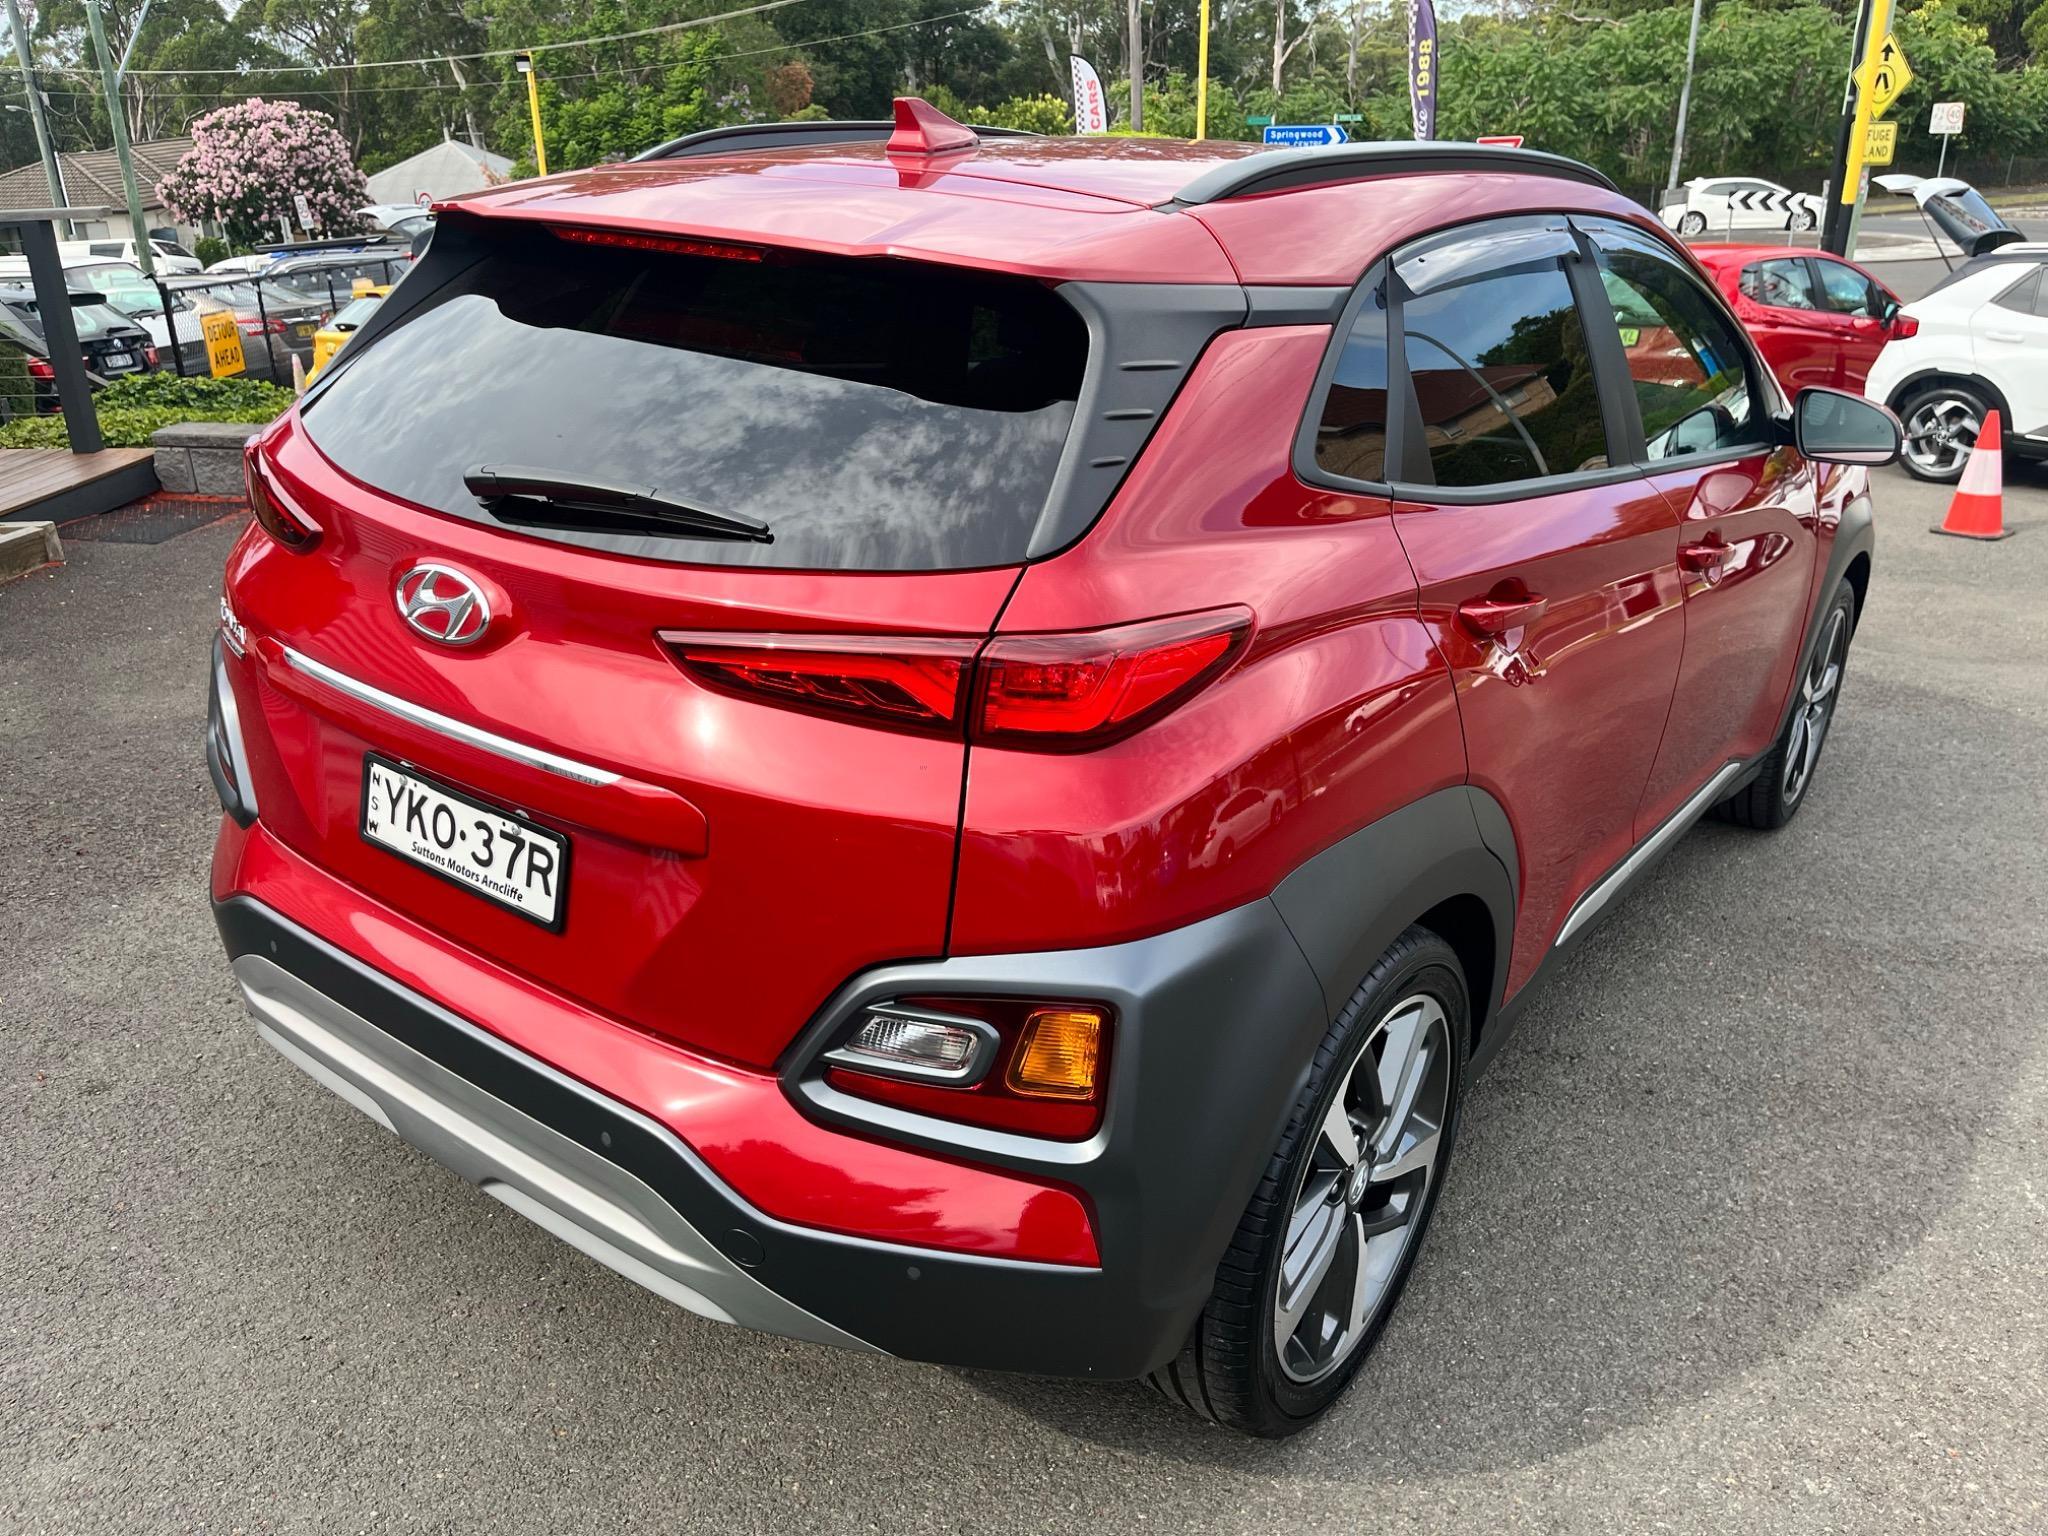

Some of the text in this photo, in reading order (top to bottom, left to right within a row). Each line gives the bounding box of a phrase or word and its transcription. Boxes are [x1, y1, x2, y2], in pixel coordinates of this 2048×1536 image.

[1416, 38, 1433, 102] 1988
[1086, 79, 1101, 130] CARS
[1270, 130, 1323, 140] Springwood
[1867, 129, 1891, 141] FUGE
[207, 321, 237, 342] DETOUR
[215, 346, 240, 369] AHEAD
[411, 841, 523, 902] Suttons Motors Arncliffe
